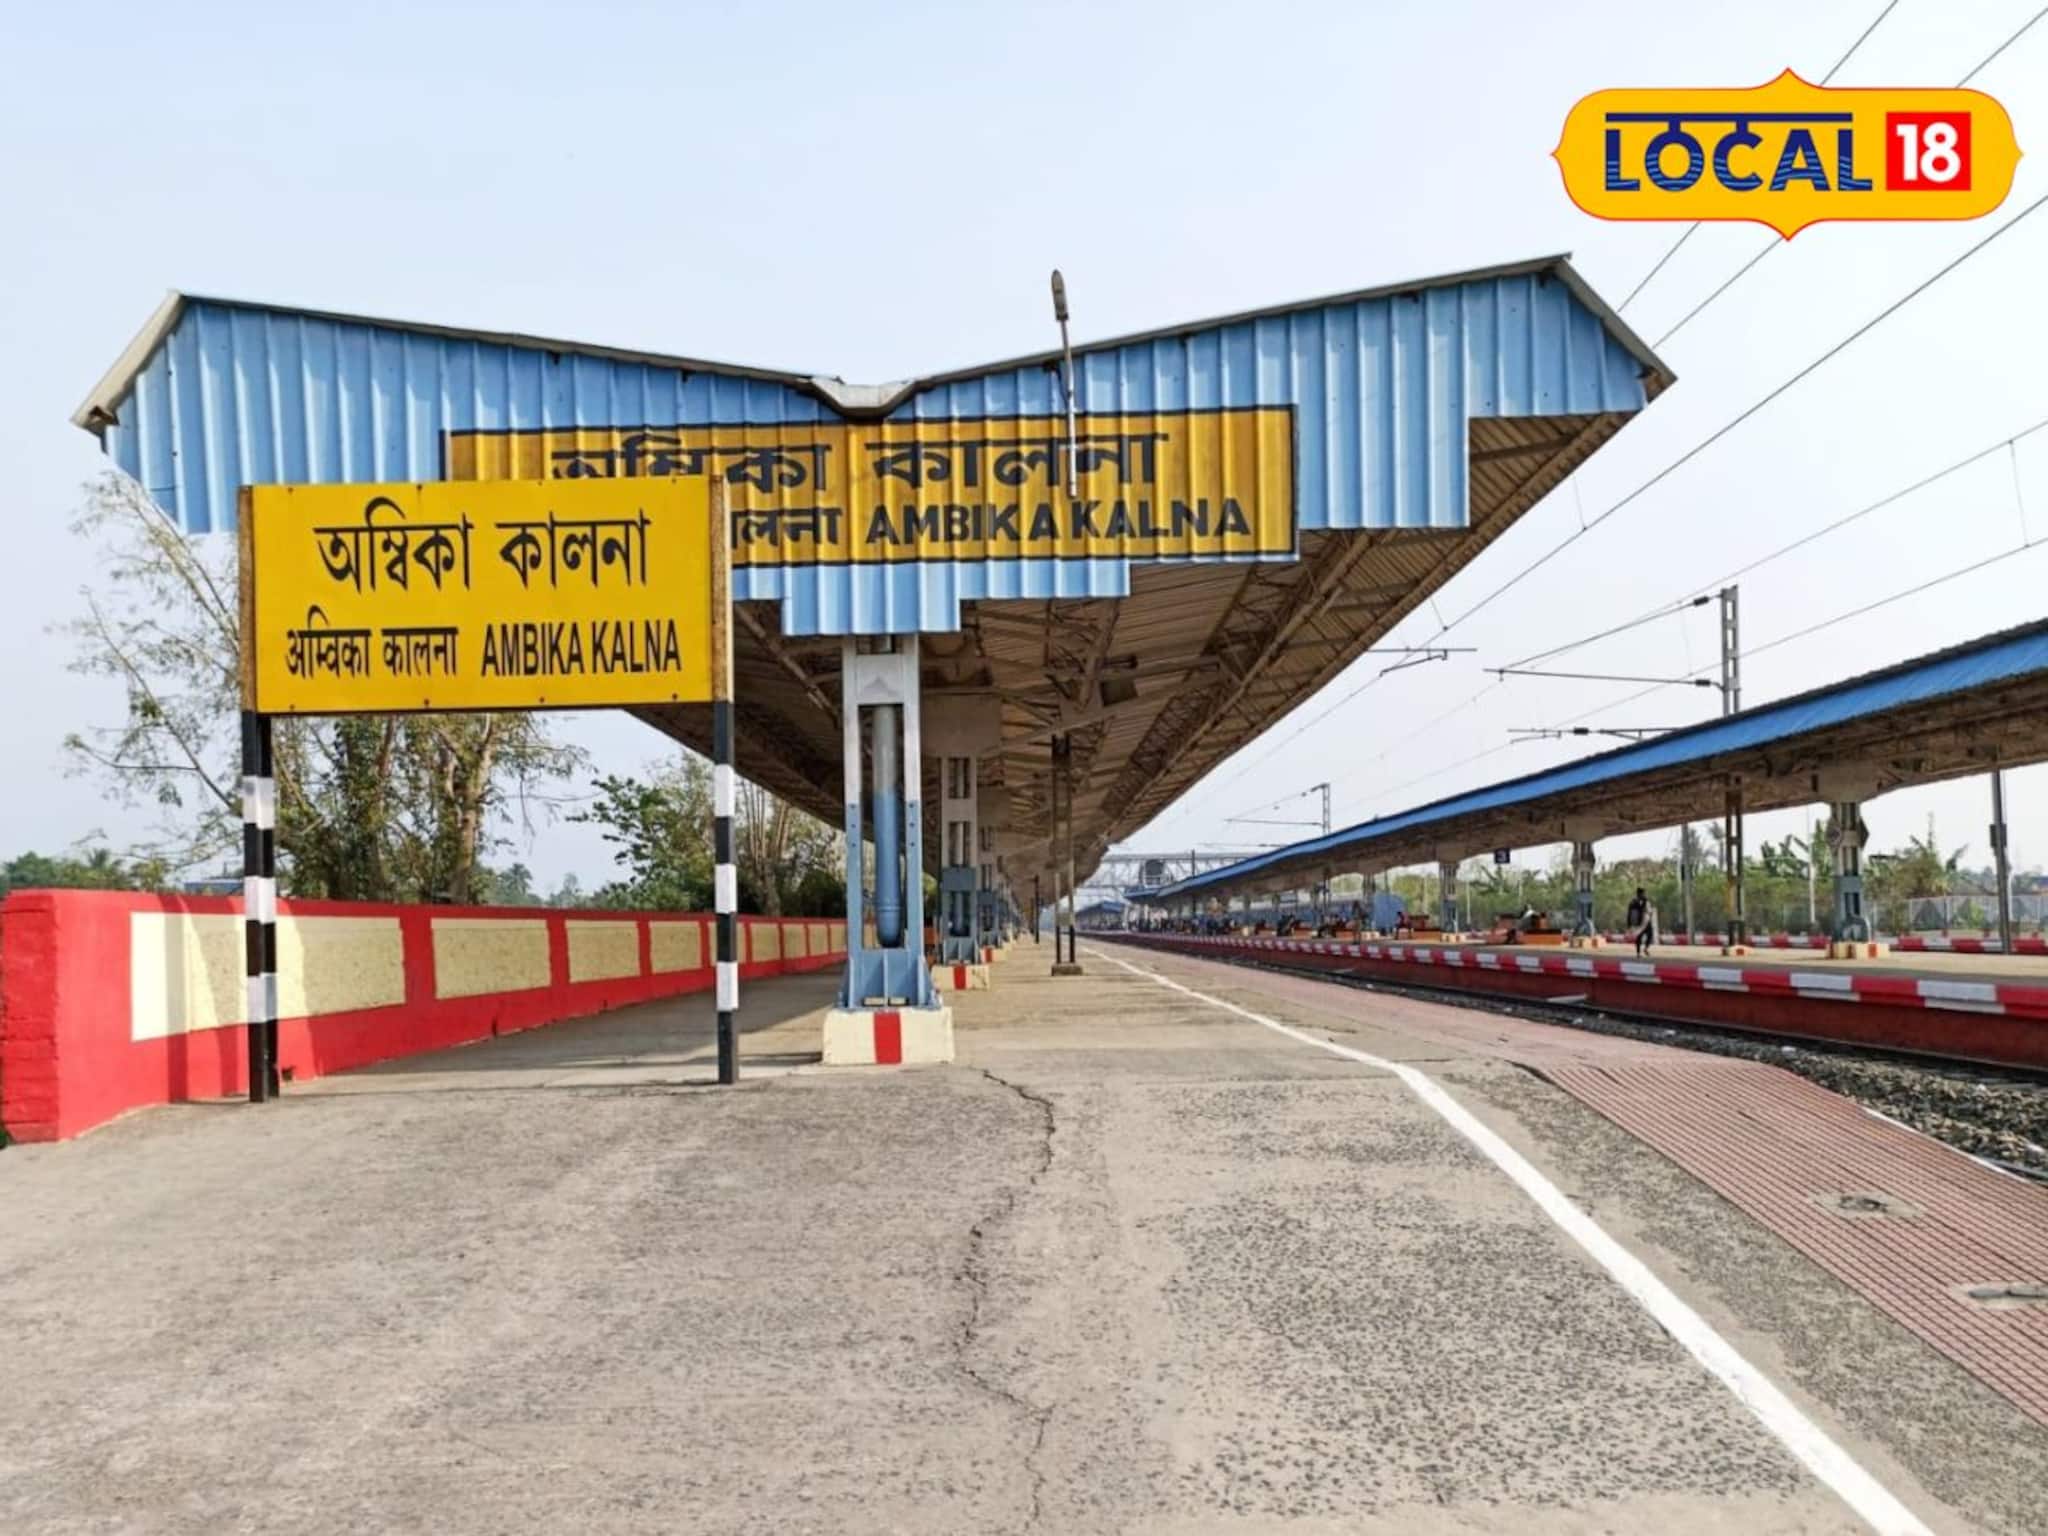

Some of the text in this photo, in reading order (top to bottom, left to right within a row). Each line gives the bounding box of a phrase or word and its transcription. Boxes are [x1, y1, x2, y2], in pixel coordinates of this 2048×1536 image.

[864, 433, 1169, 488] কালনা
[312, 496, 651, 594] অম্বিকা কালনা
[865, 498, 1251, 545] AMBIKA KALNA
[381, 626, 458, 677] कालना
[481, 618, 682, 677] AMBIKA KALNA
